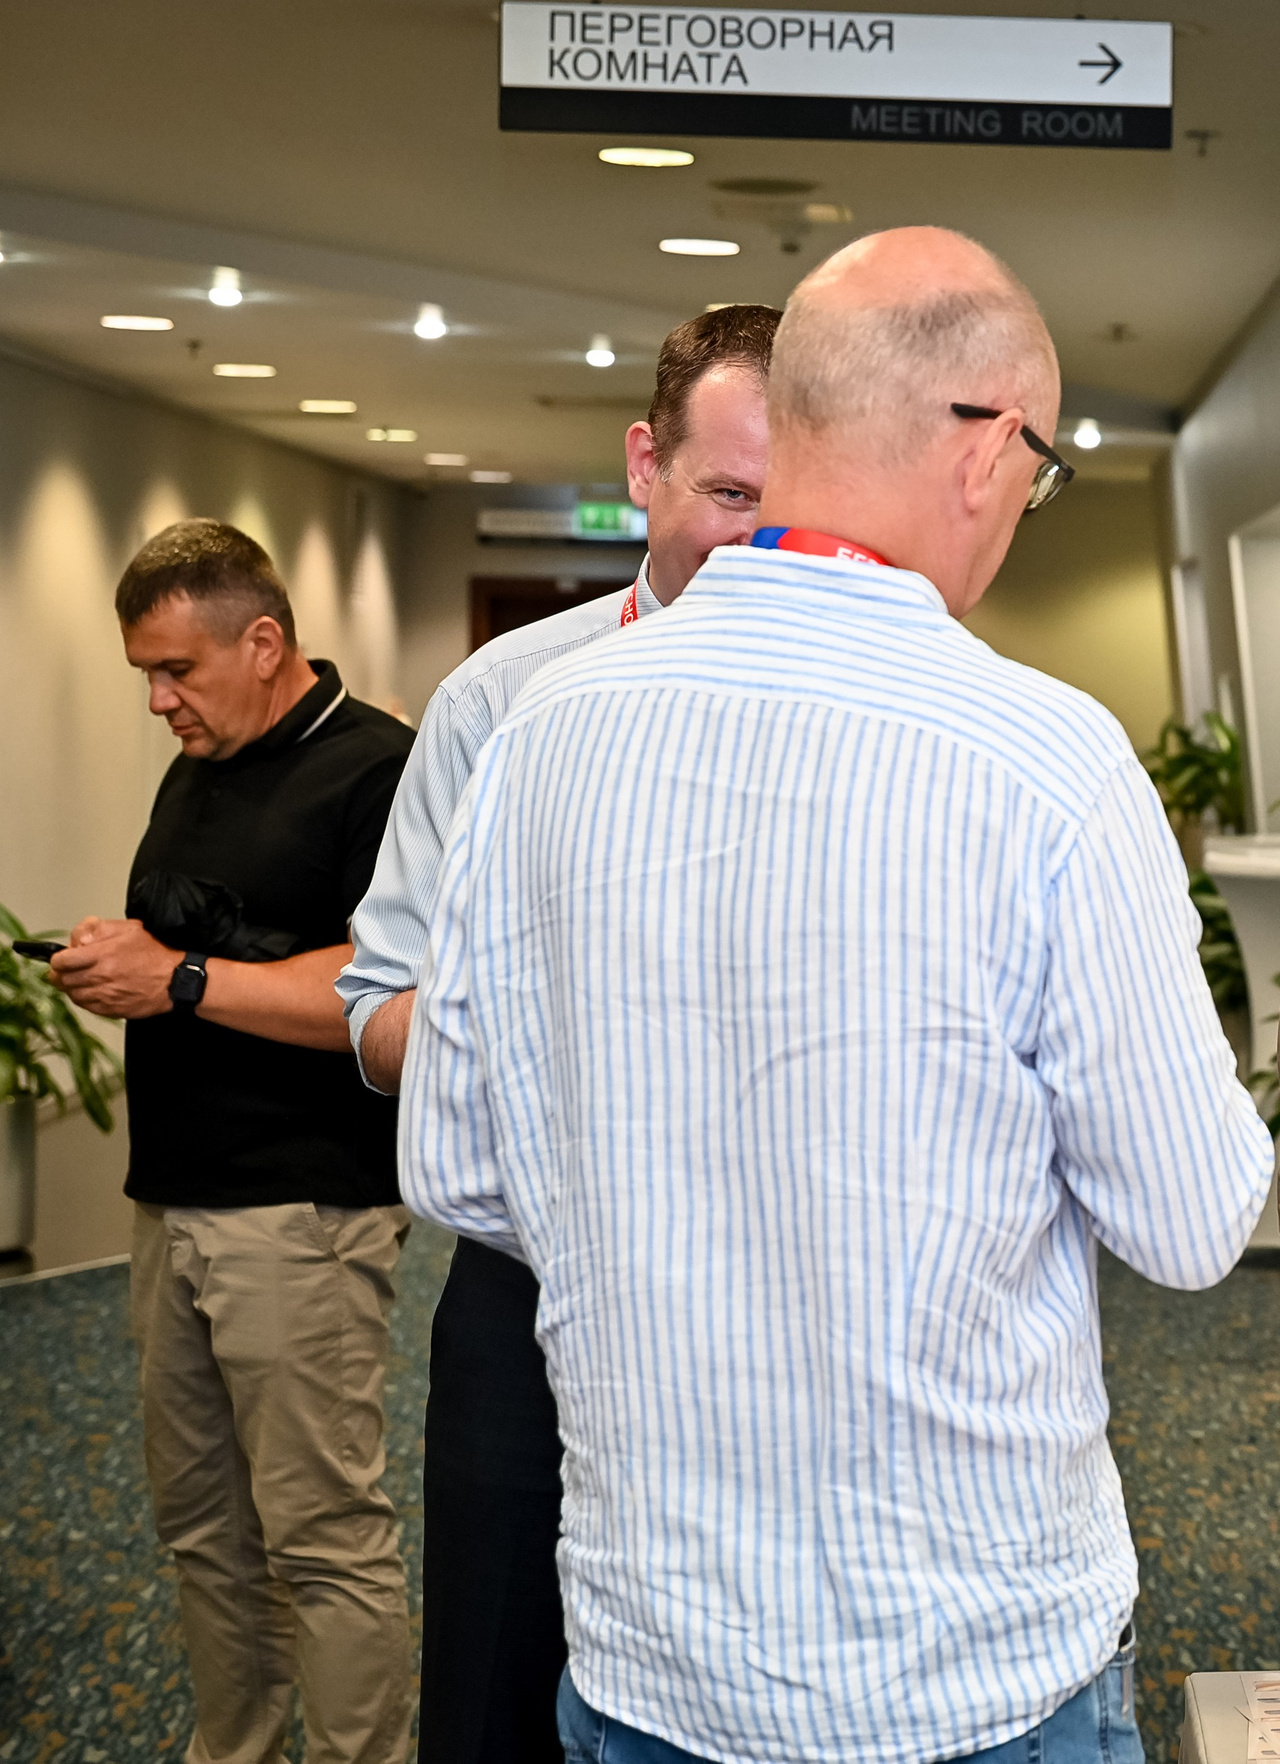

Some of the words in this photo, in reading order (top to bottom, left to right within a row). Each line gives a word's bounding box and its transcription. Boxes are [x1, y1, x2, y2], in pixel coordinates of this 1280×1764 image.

[548, 10, 895, 53] ПЕРЕГОВОРНАЯ
[547, 48, 750, 86] КОМНАТА
[851, 104, 1001, 137] MEETING
[1020, 110, 1124, 139] ROOM
